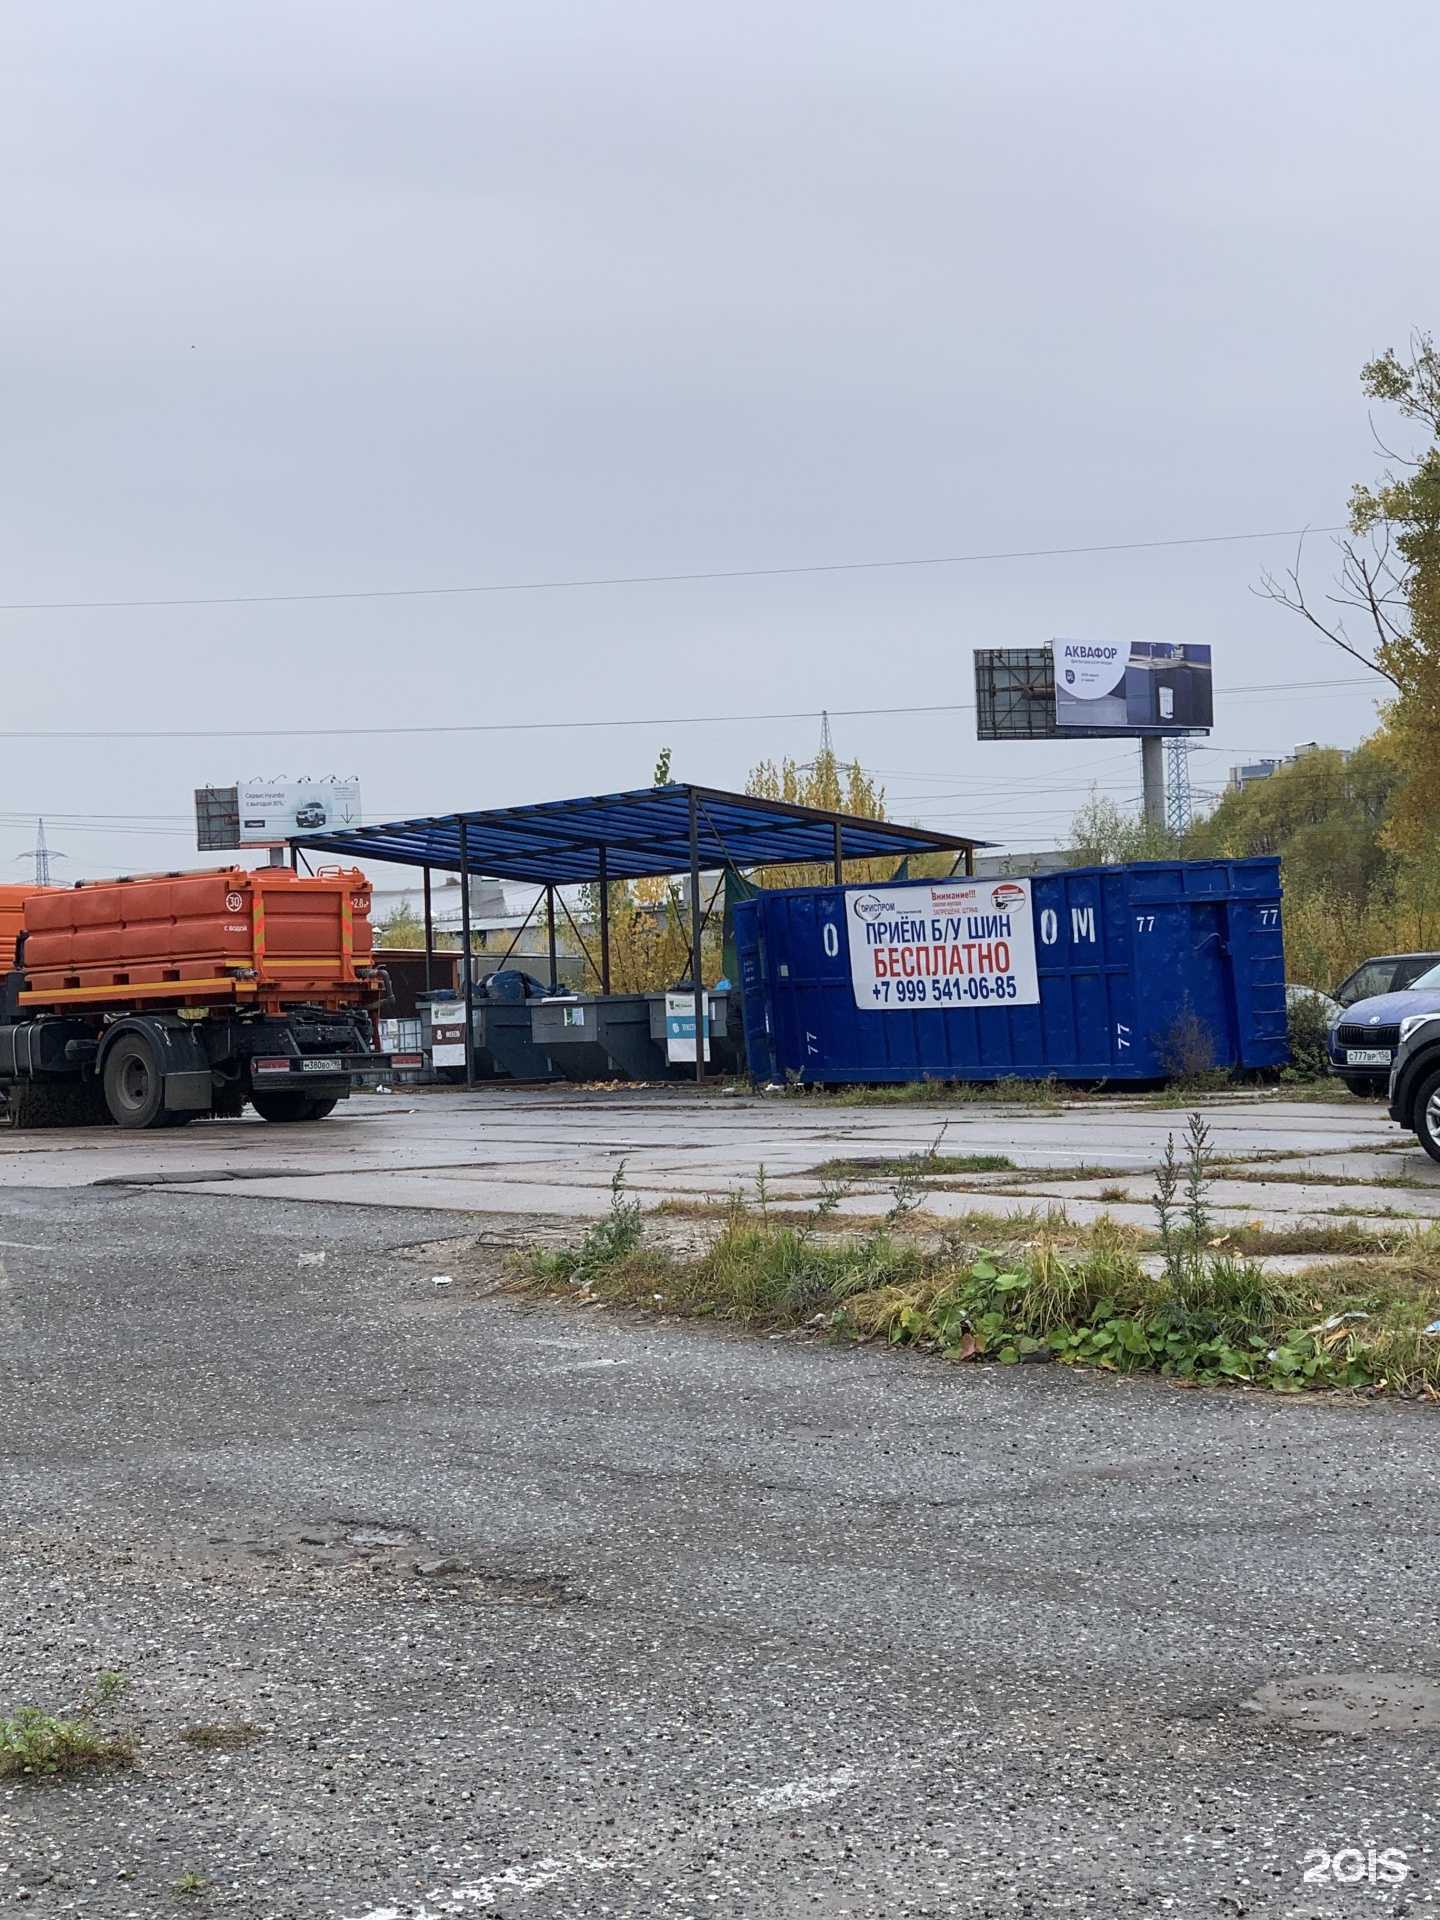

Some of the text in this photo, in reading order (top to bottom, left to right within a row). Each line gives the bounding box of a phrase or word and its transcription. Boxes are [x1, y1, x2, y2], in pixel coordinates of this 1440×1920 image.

[1064, 645, 1118, 659] АКВАФОР
[1136, 916, 1156, 933] 77
[1260, 909, 1279, 926] 77
[866, 914, 1012, 945] ПРИЁМ Б/У ШИН
[873, 941, 1010, 978] БЕСПЛАТНО
[872, 975, 1017, 1003] +7 999 541-06-85
